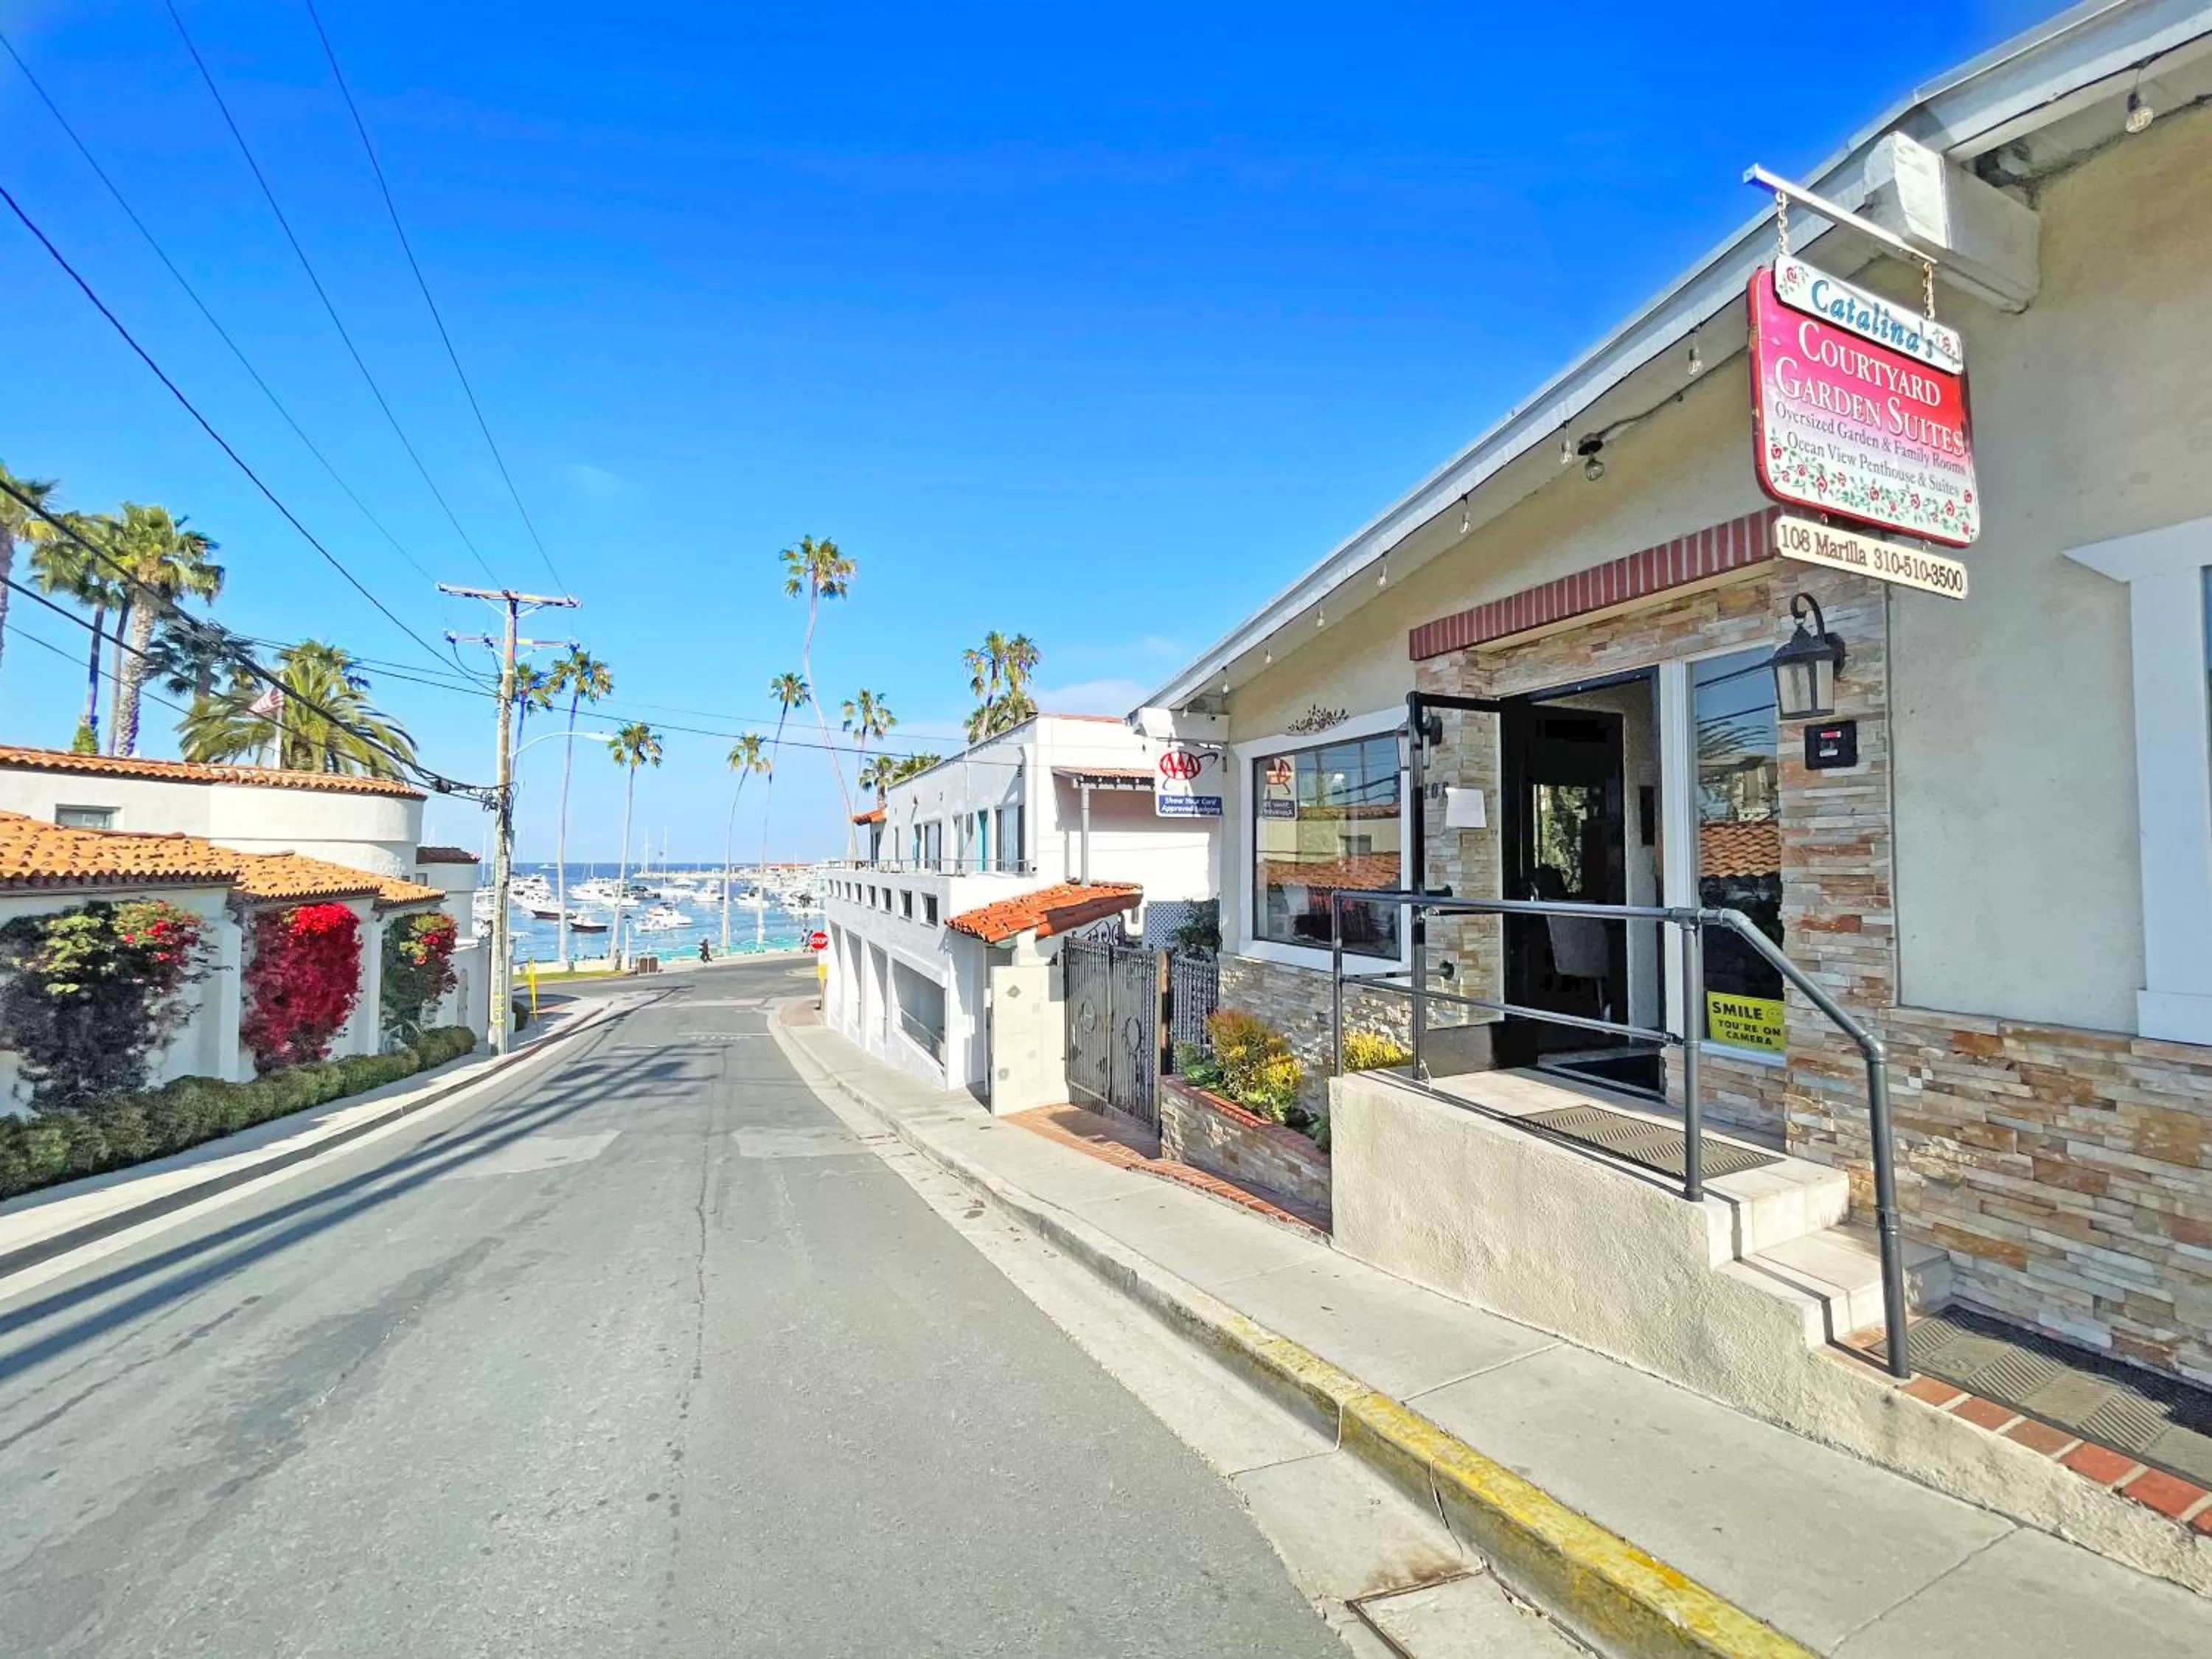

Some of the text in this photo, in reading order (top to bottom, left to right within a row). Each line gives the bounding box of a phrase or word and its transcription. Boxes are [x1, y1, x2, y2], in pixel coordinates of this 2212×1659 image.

[1811, 279, 1933, 359] Catalina's
[1798, 321, 1941, 407] COURTYARD
[1774, 356, 1965, 458] GARDEN SUITES
[1775, 400, 1966, 476] Oversized Garden & Family Rooms
[1787, 431, 1960, 497] Ocean View Penthouse & Suites
[1780, 524, 1964, 593] 108 Marilla 310-510-3500
[1162, 752, 1200, 779] AAA
[1711, 1001, 1764, 1021] SMILE
[1718, 1019, 1781, 1037] YOU'RE ON
[1725, 1031, 1773, 1046] CAMERA
